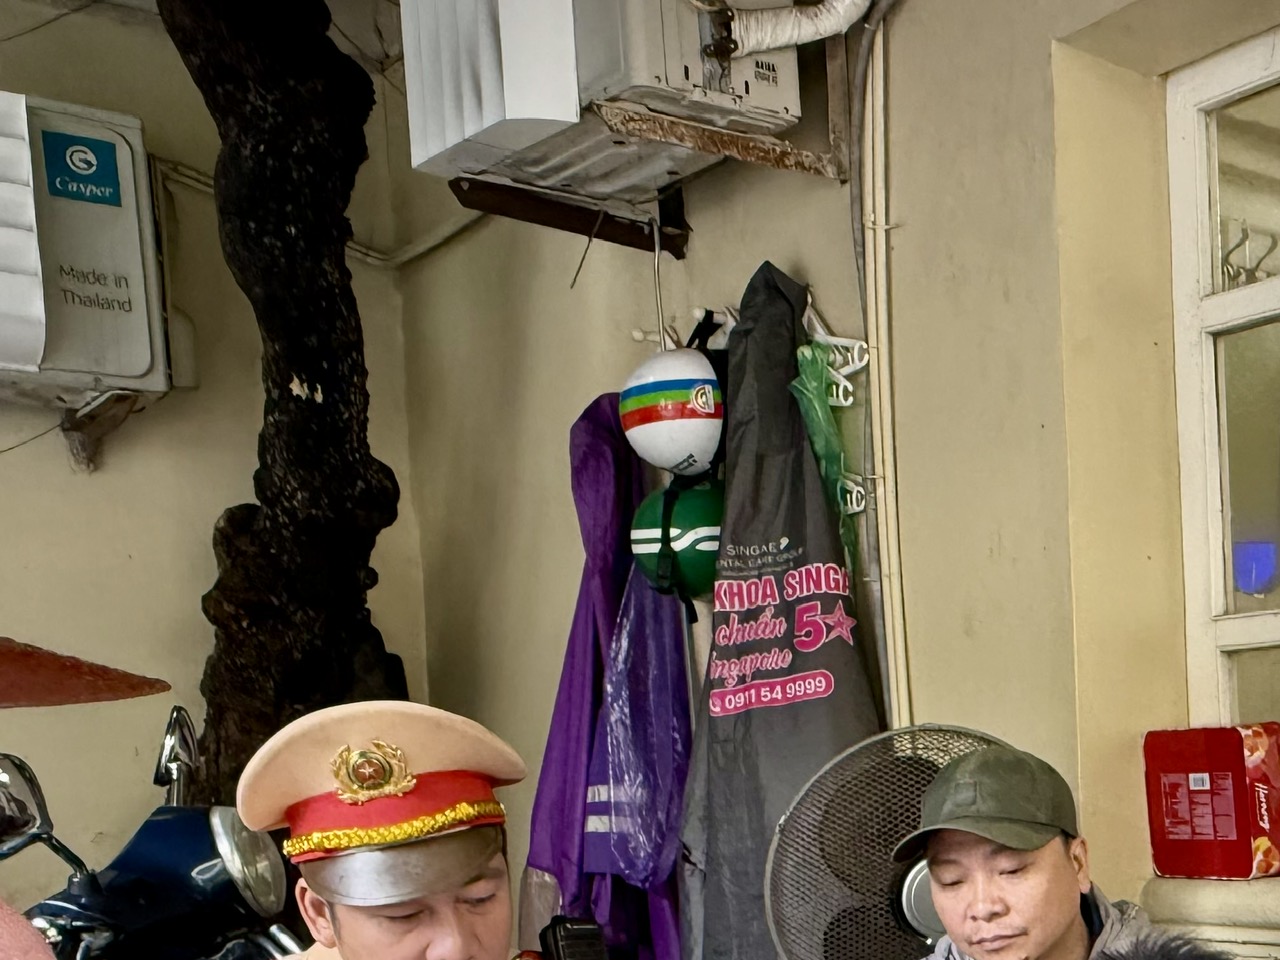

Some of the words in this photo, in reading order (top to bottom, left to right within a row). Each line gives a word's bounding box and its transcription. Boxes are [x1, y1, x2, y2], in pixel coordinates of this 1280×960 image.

[55, 176, 114, 199] Casper
[60, 264, 107, 287] Made
[114, 274, 130, 289] in
[61, 289, 133, 313] Thailand
[714, 575, 780, 612] KHOA
[793, 601, 827, 652] 5
[724, 688, 757, 709] 0911
[760, 687, 783, 702] 54
[786, 676, 827, 698] 9999
